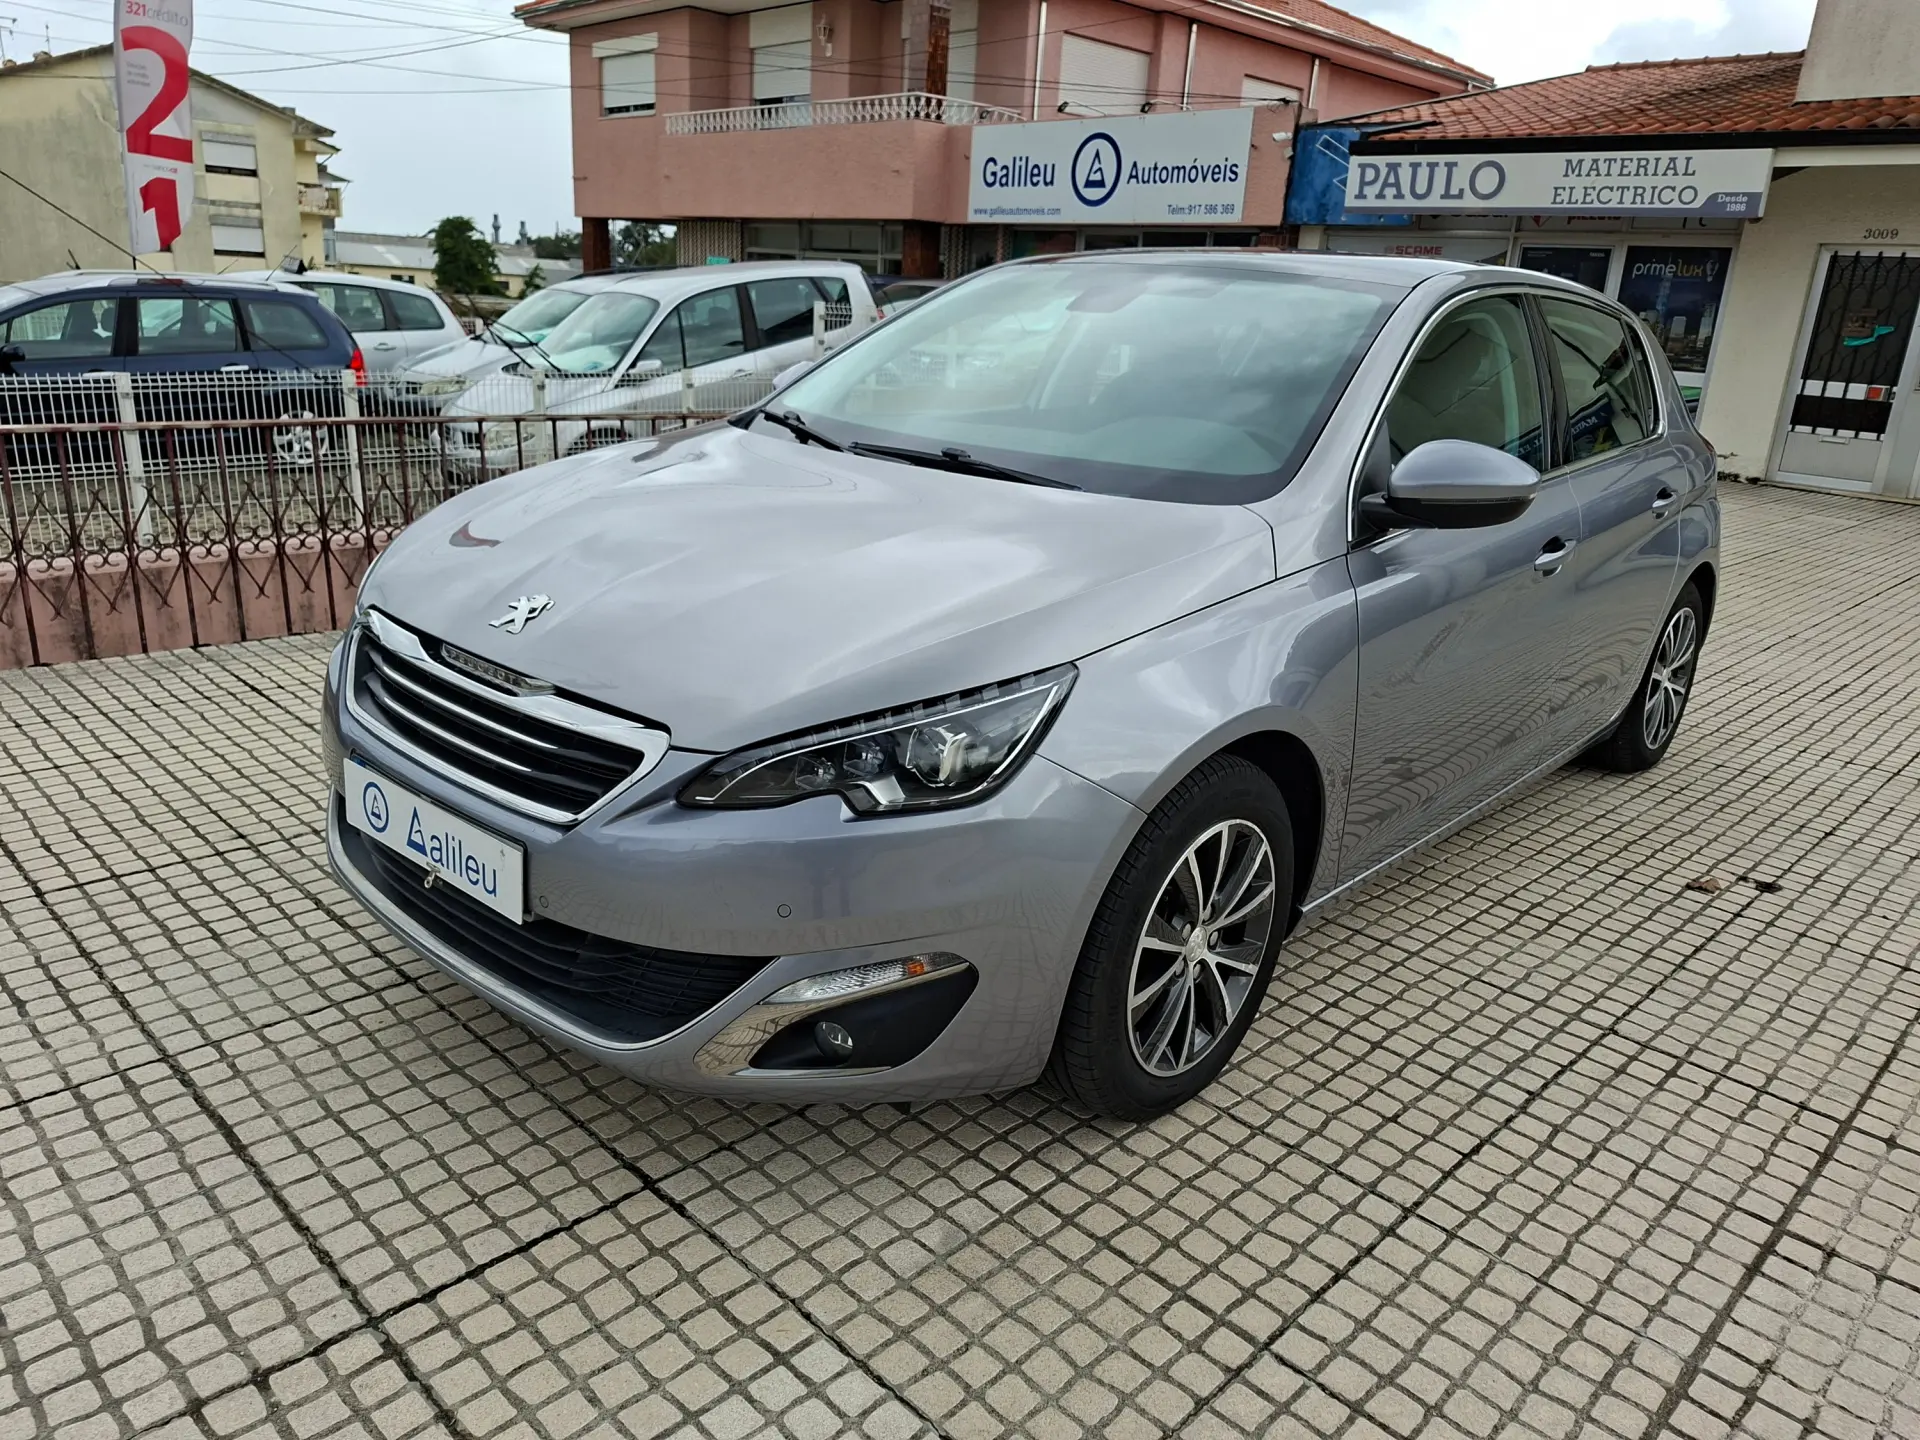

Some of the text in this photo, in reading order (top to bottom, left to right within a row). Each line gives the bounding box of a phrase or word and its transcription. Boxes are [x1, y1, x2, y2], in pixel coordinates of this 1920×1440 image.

[120, 26, 193, 164] 2
[983, 156, 1239, 188] Galileu Automóveis
[1563, 157, 1696, 178] MATERIAL
[1353, 160, 1507, 201] PAULO
[1550, 185, 1699, 206] ELECTRICO
[1717, 193, 1748, 203] Desde
[140, 177, 182, 252] 1
[1203, 204, 1218, 215] 586
[1219, 203, 1235, 214] 369
[1726, 203, 1746, 212] 1986
[1863, 228, 1899, 239] 3009
[1395, 245, 1443, 255] SCAME
